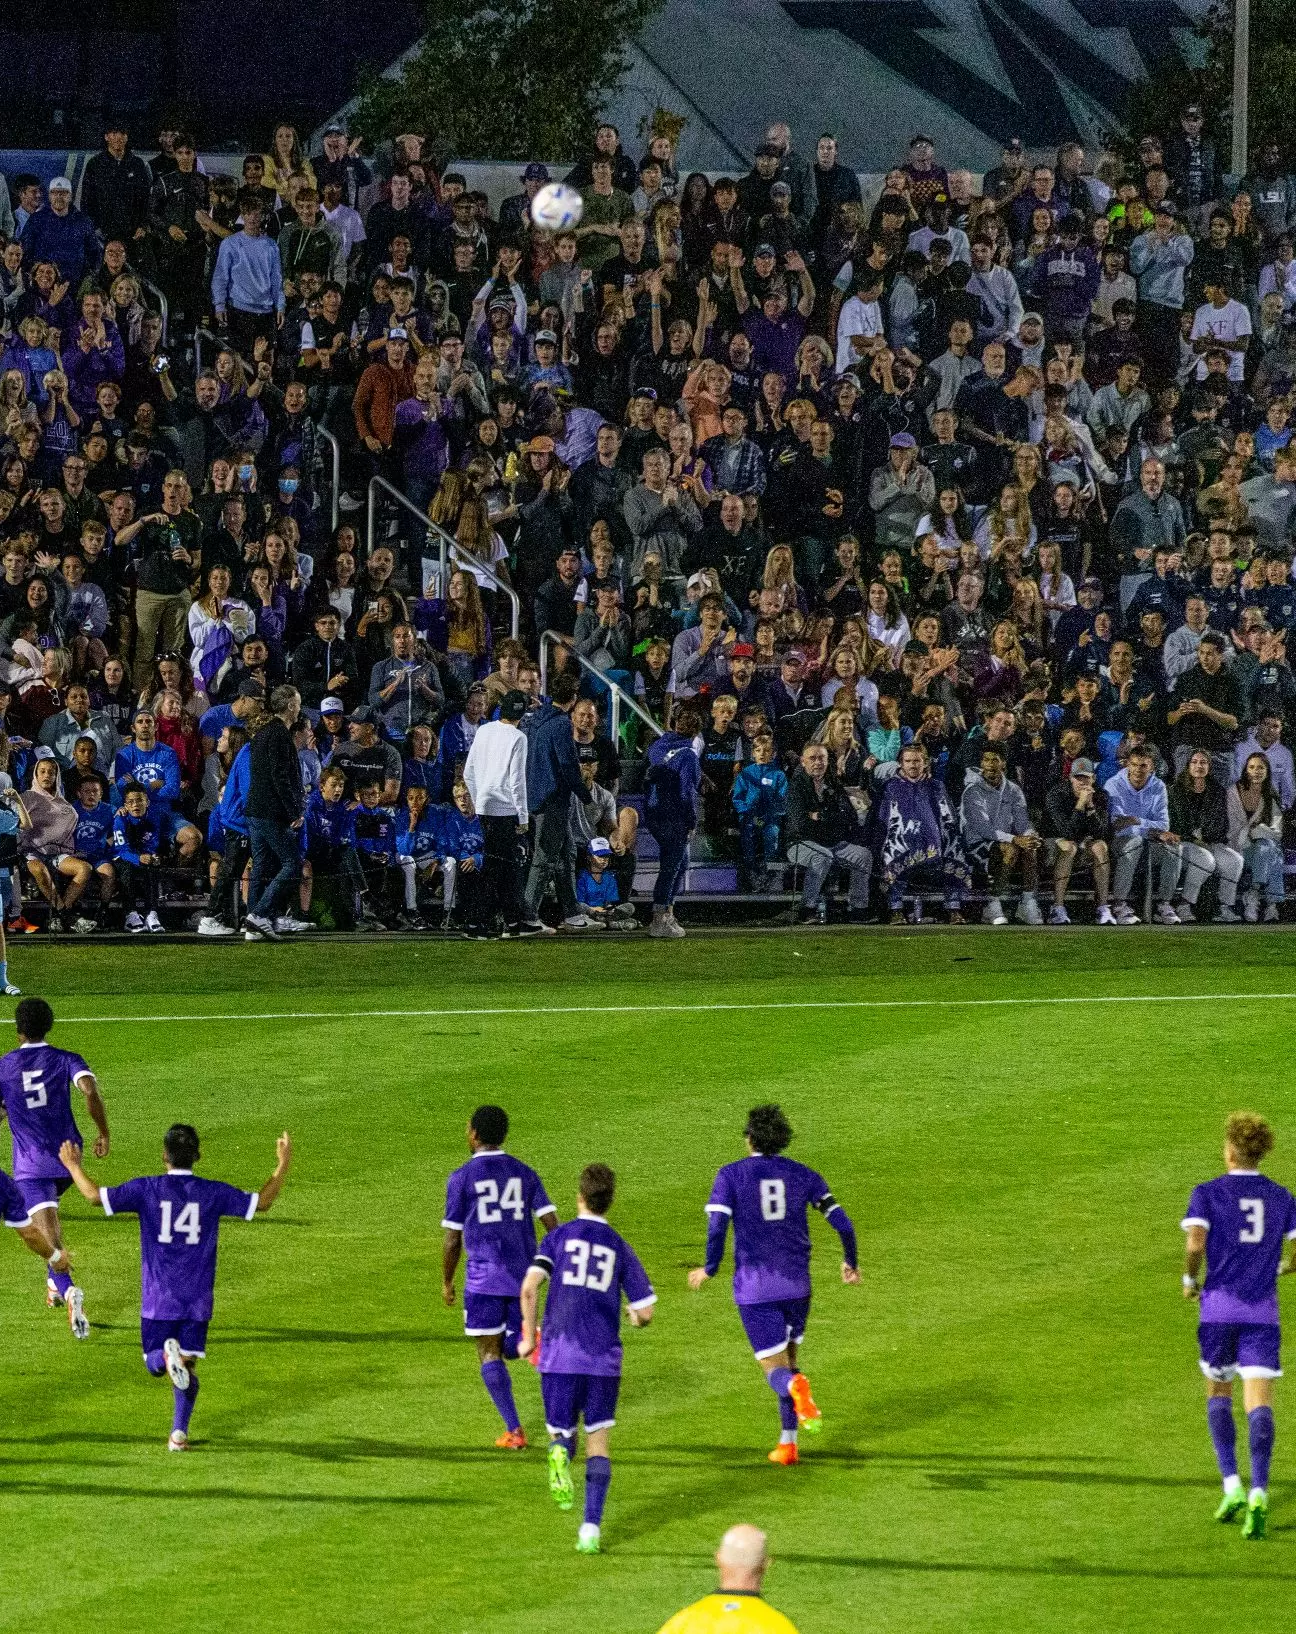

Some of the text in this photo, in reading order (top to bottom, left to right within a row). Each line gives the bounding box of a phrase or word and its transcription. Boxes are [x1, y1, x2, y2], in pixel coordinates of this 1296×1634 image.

[340, 759, 383, 771] Champion
[21, 1069, 47, 1109] 5
[474, 1177, 525, 1224] 24
[759, 1178, 786, 1221] 8
[1239, 1198, 1265, 1243] 3
[157, 1200, 201, 1245] 14
[562, 1238, 616, 1293] 33
